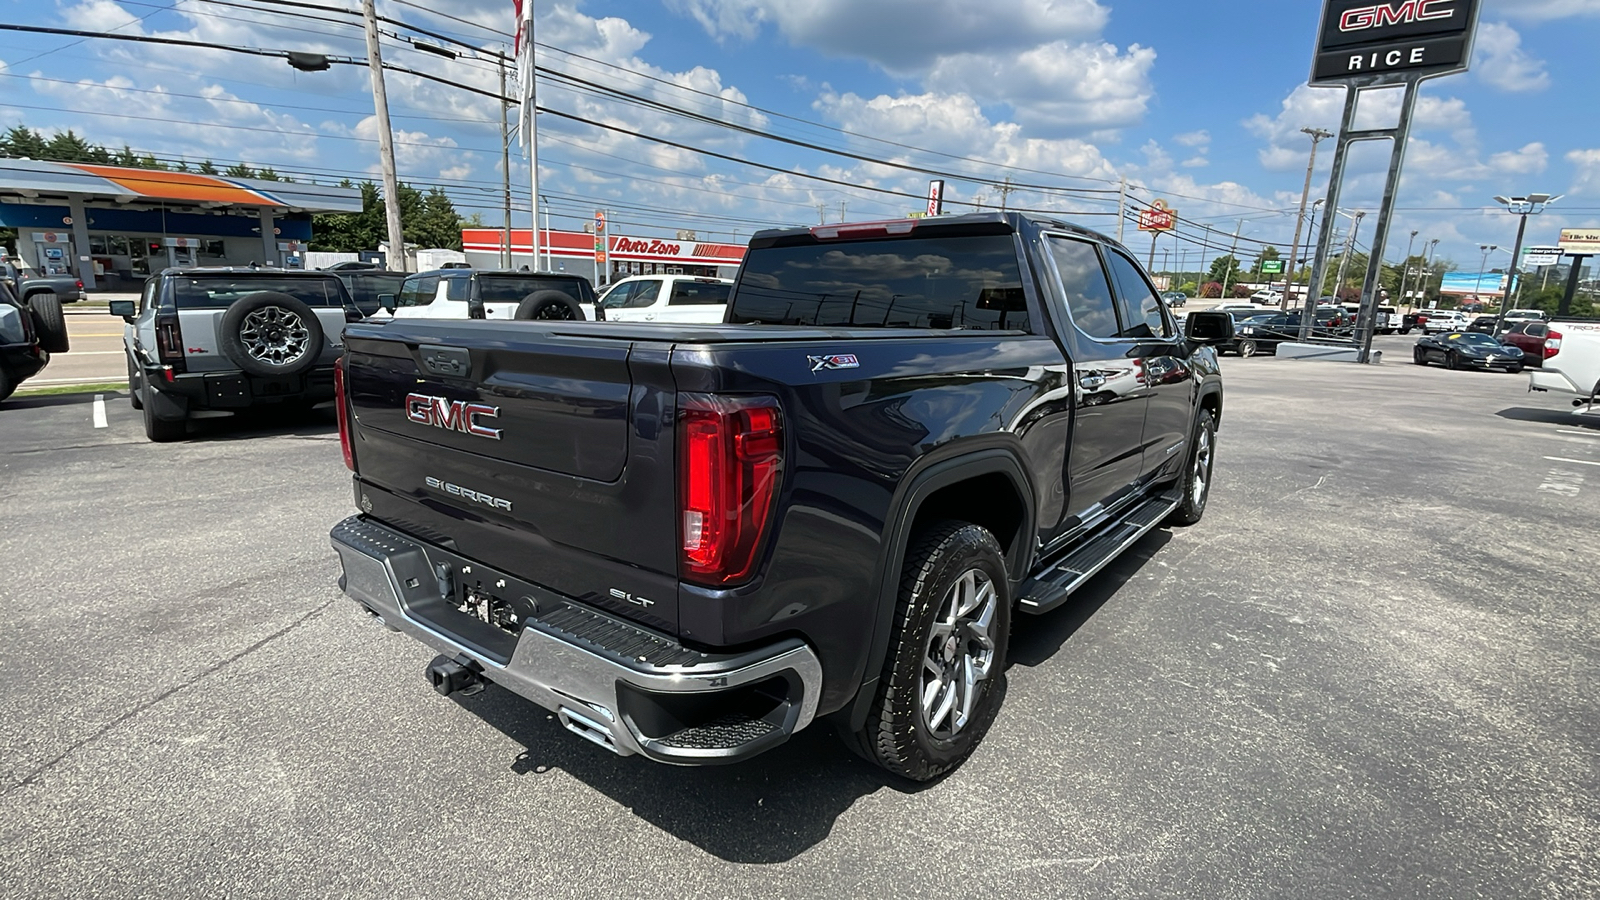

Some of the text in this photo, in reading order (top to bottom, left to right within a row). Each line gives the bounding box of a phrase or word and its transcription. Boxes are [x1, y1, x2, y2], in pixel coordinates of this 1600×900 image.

[1339, 0, 1456, 32] GMC
[1348, 47, 1425, 70] RICE
[615, 237, 681, 255] AutoZone
[405, 392, 503, 440] GMC
[425, 476, 512, 512] SIERRA
[608, 587, 656, 608] SLT
